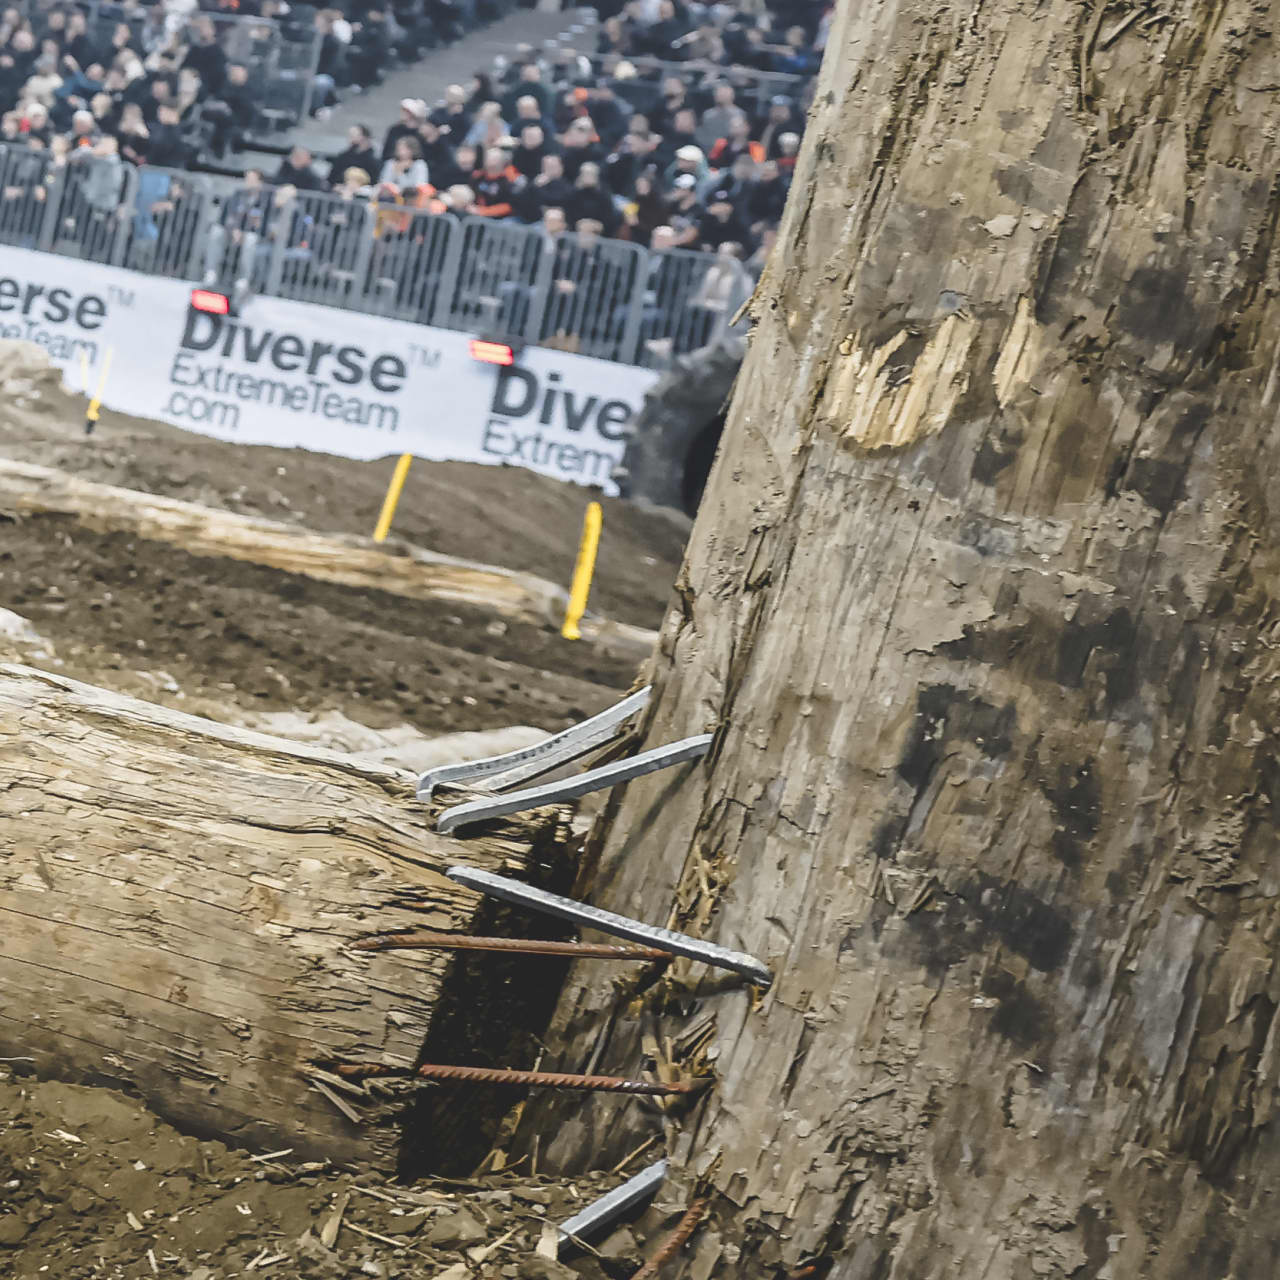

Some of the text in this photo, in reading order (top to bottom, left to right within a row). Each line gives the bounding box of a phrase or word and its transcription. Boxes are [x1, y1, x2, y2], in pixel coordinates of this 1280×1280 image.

[179, 306, 407, 394] Diverse
[161, 392, 240, 431] .com
[170, 353, 400, 432] ExtremeTeam
[491, 365, 633, 442] Dive
[482, 419, 619, 480] Extrem
